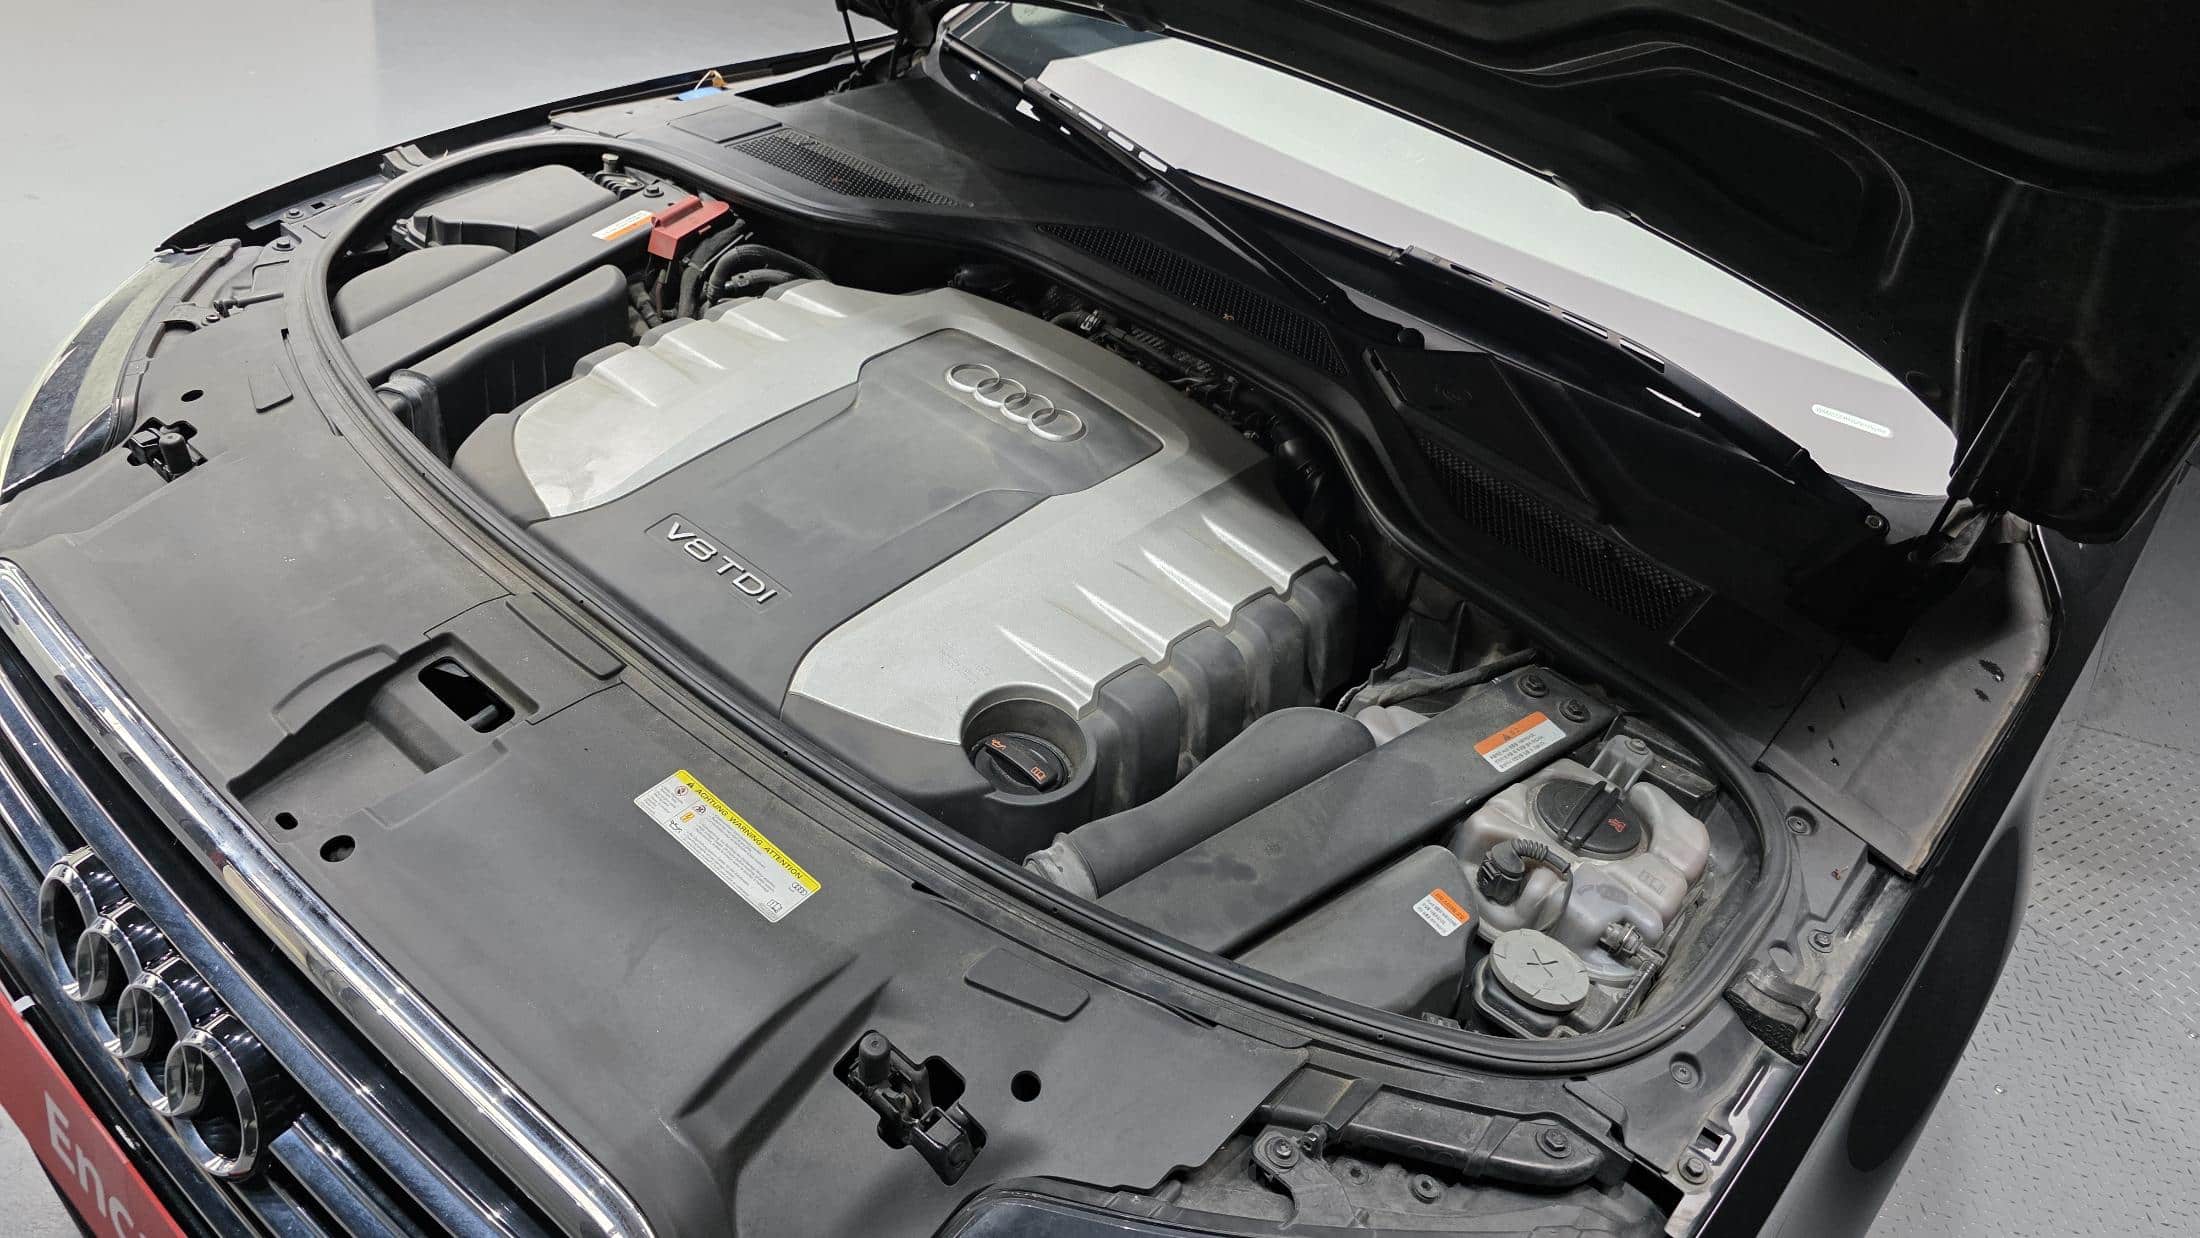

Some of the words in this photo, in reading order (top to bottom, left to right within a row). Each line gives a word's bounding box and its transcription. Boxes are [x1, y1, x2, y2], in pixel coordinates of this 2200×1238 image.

[668, 521, 717, 562] V8
[716, 555, 777, 604] TDI
[695, 789, 729, 816] ACHTUNG
[728, 816, 763, 845] WARNING
[764, 847, 803, 879] ATTENTION
[44, 1090, 146, 1238] Enc
